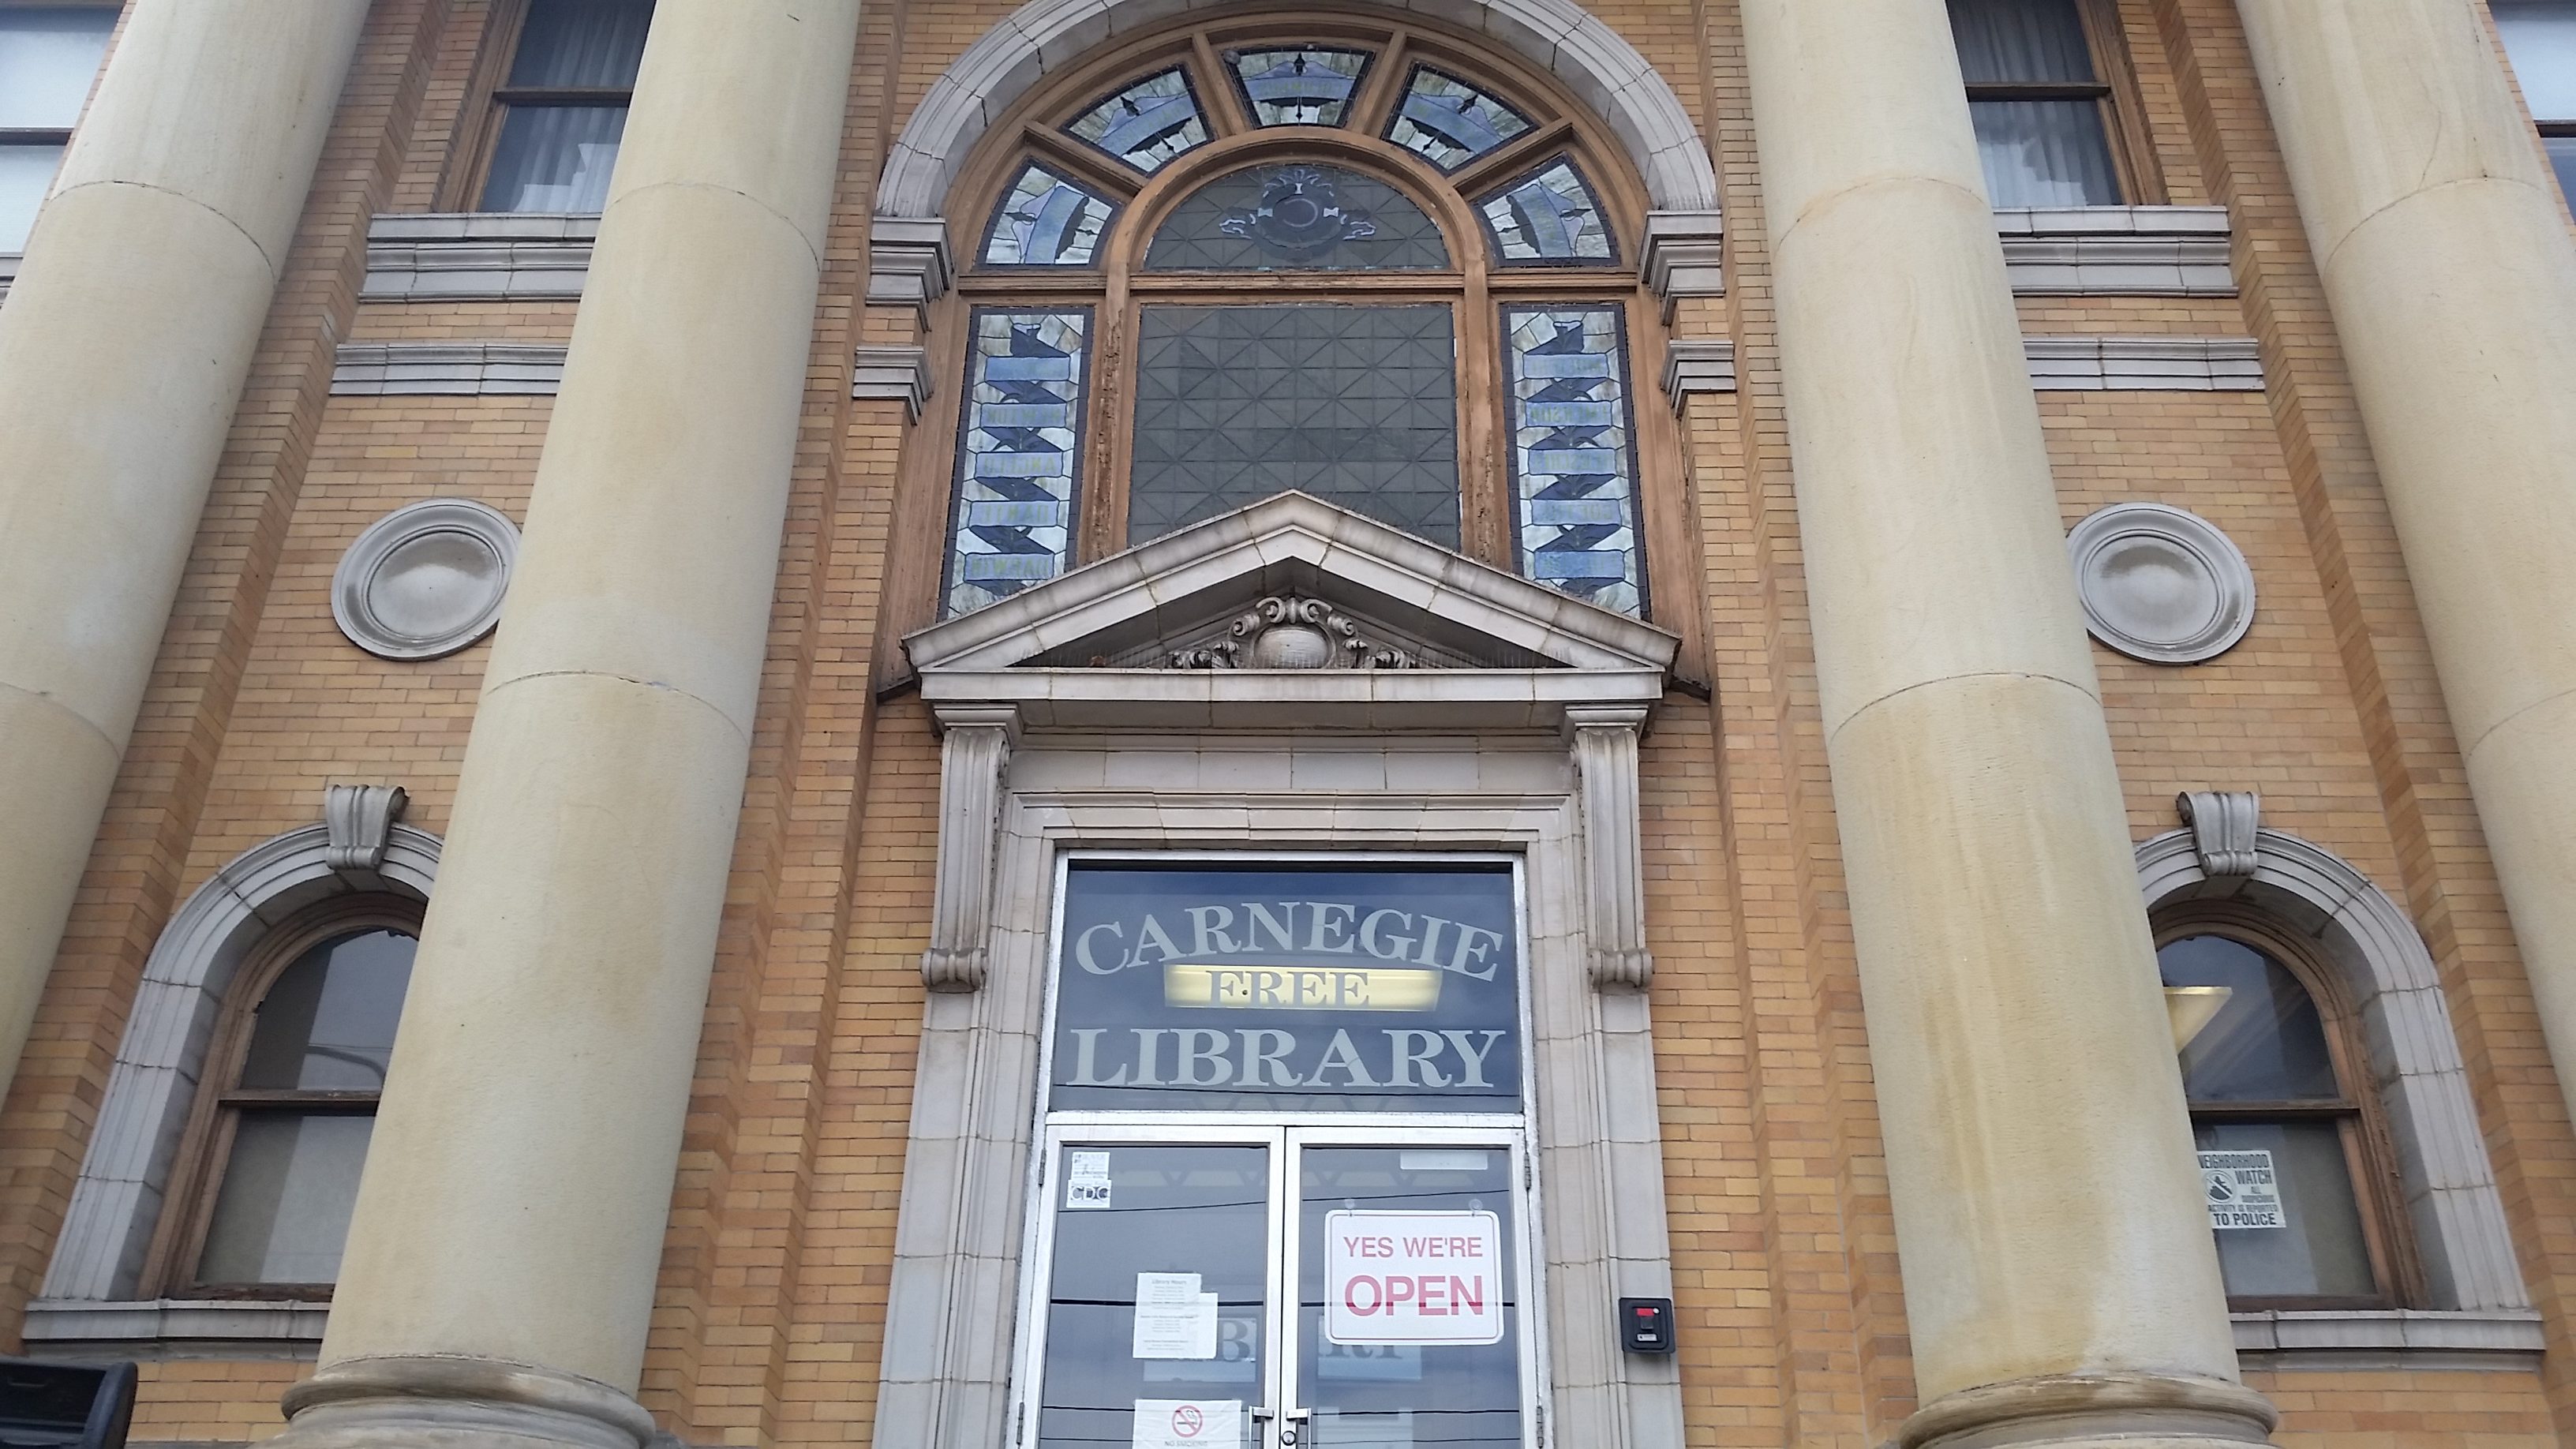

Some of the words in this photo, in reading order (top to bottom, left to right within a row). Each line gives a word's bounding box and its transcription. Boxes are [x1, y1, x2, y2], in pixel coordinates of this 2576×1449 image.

[1075, 900, 1504, 983] CARNEGIE
[1205, 969, 1369, 1009] FREE
[1065, 1028, 1506, 1088] LIBRARY
[2235, 1170, 2273, 1185] WATCH
[2213, 1213, 2230, 1226] TO
[2233, 1212, 2277, 1226] POLICE
[1343, 1237, 1395, 1257] YES
[1402, 1237, 1484, 1257] WE'RE
[1345, 1275, 1484, 1316] OPEN
